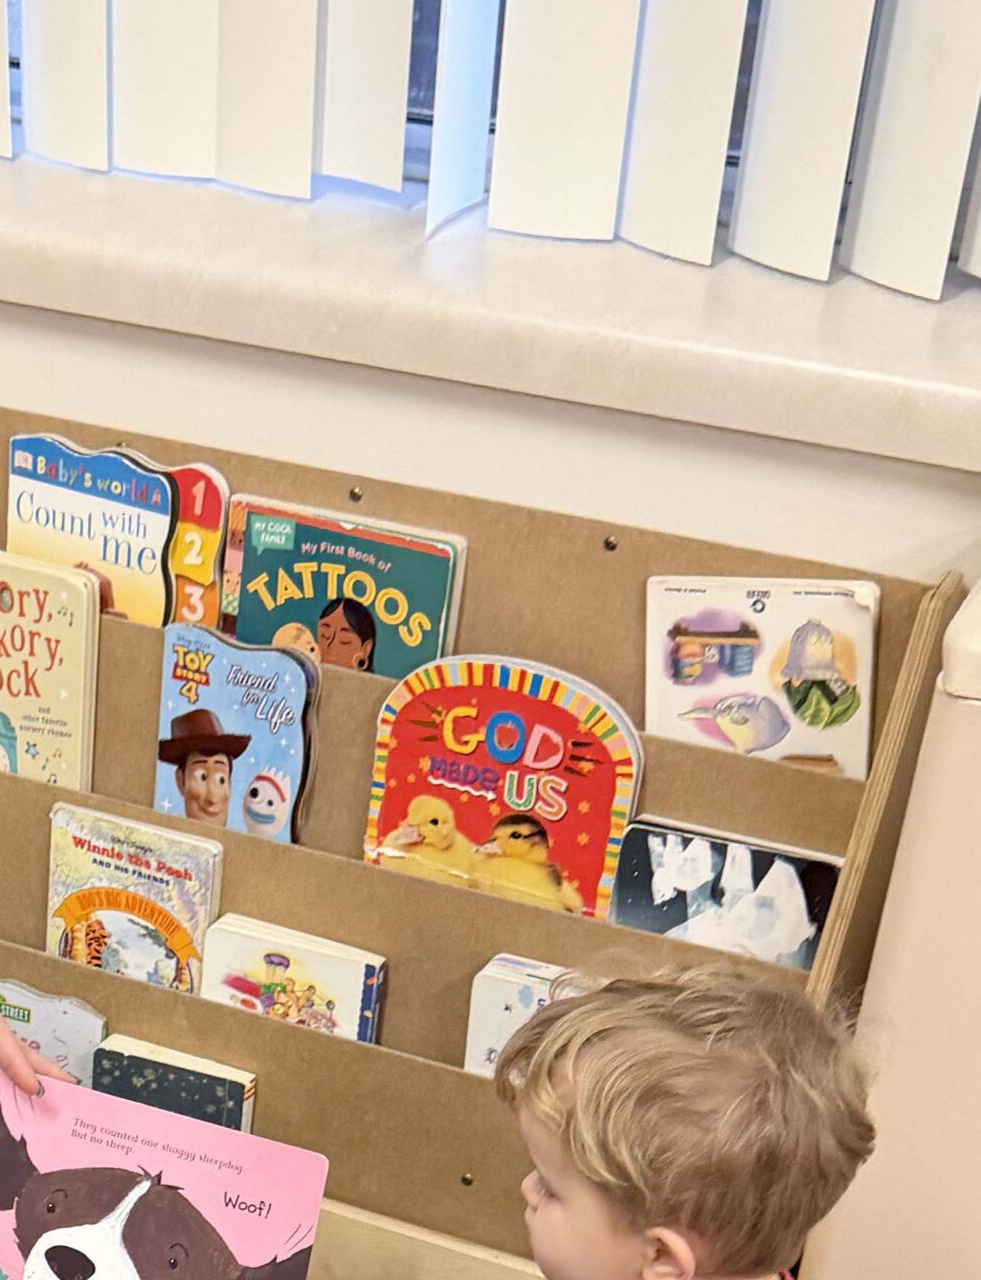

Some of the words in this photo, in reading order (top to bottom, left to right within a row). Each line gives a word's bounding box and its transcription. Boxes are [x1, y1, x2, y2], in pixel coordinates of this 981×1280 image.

[36, 455, 93, 488] Baby's
[16, 490, 96, 540] Count
[102, 511, 147, 539] with
[191, 480, 207, 516] 1
[101, 535, 157, 575] me
[183, 532, 204, 566] 2
[301, 543, 317, 555] My
[320, 541, 345, 556] First
[347, 548, 376, 566] Book
[378, 560, 392, 574] of
[181, 586, 204, 622] 3
[246, 562, 432, 647] TATTOOS
[172, 644, 215, 673] TOY
[180, 680, 199, 705] 4
[226, 664, 279, 692] Friend
[255, 696, 295, 734] Life
[443, 706, 564, 770] GOD
[503, 770, 569, 821] US
[72, 835, 123, 861] Winnie
[126, 853, 151, 870] the
[156, 859, 192, 881] Pooh
[92, 858, 111, 869] AND
[114, 864, 129, 874] HIS
[1, 1003, 29, 1020] STREET
[71, 1129, 87, 1140] But
[89, 1135, 103, 1145] no
[74, 1117, 97, 1133] They
[100, 1126, 138, 1144] counted
[140, 1138, 158, 1148] one
[162, 1143, 196, 1162] shaggy
[223, 1192, 272, 1219] Woof!
